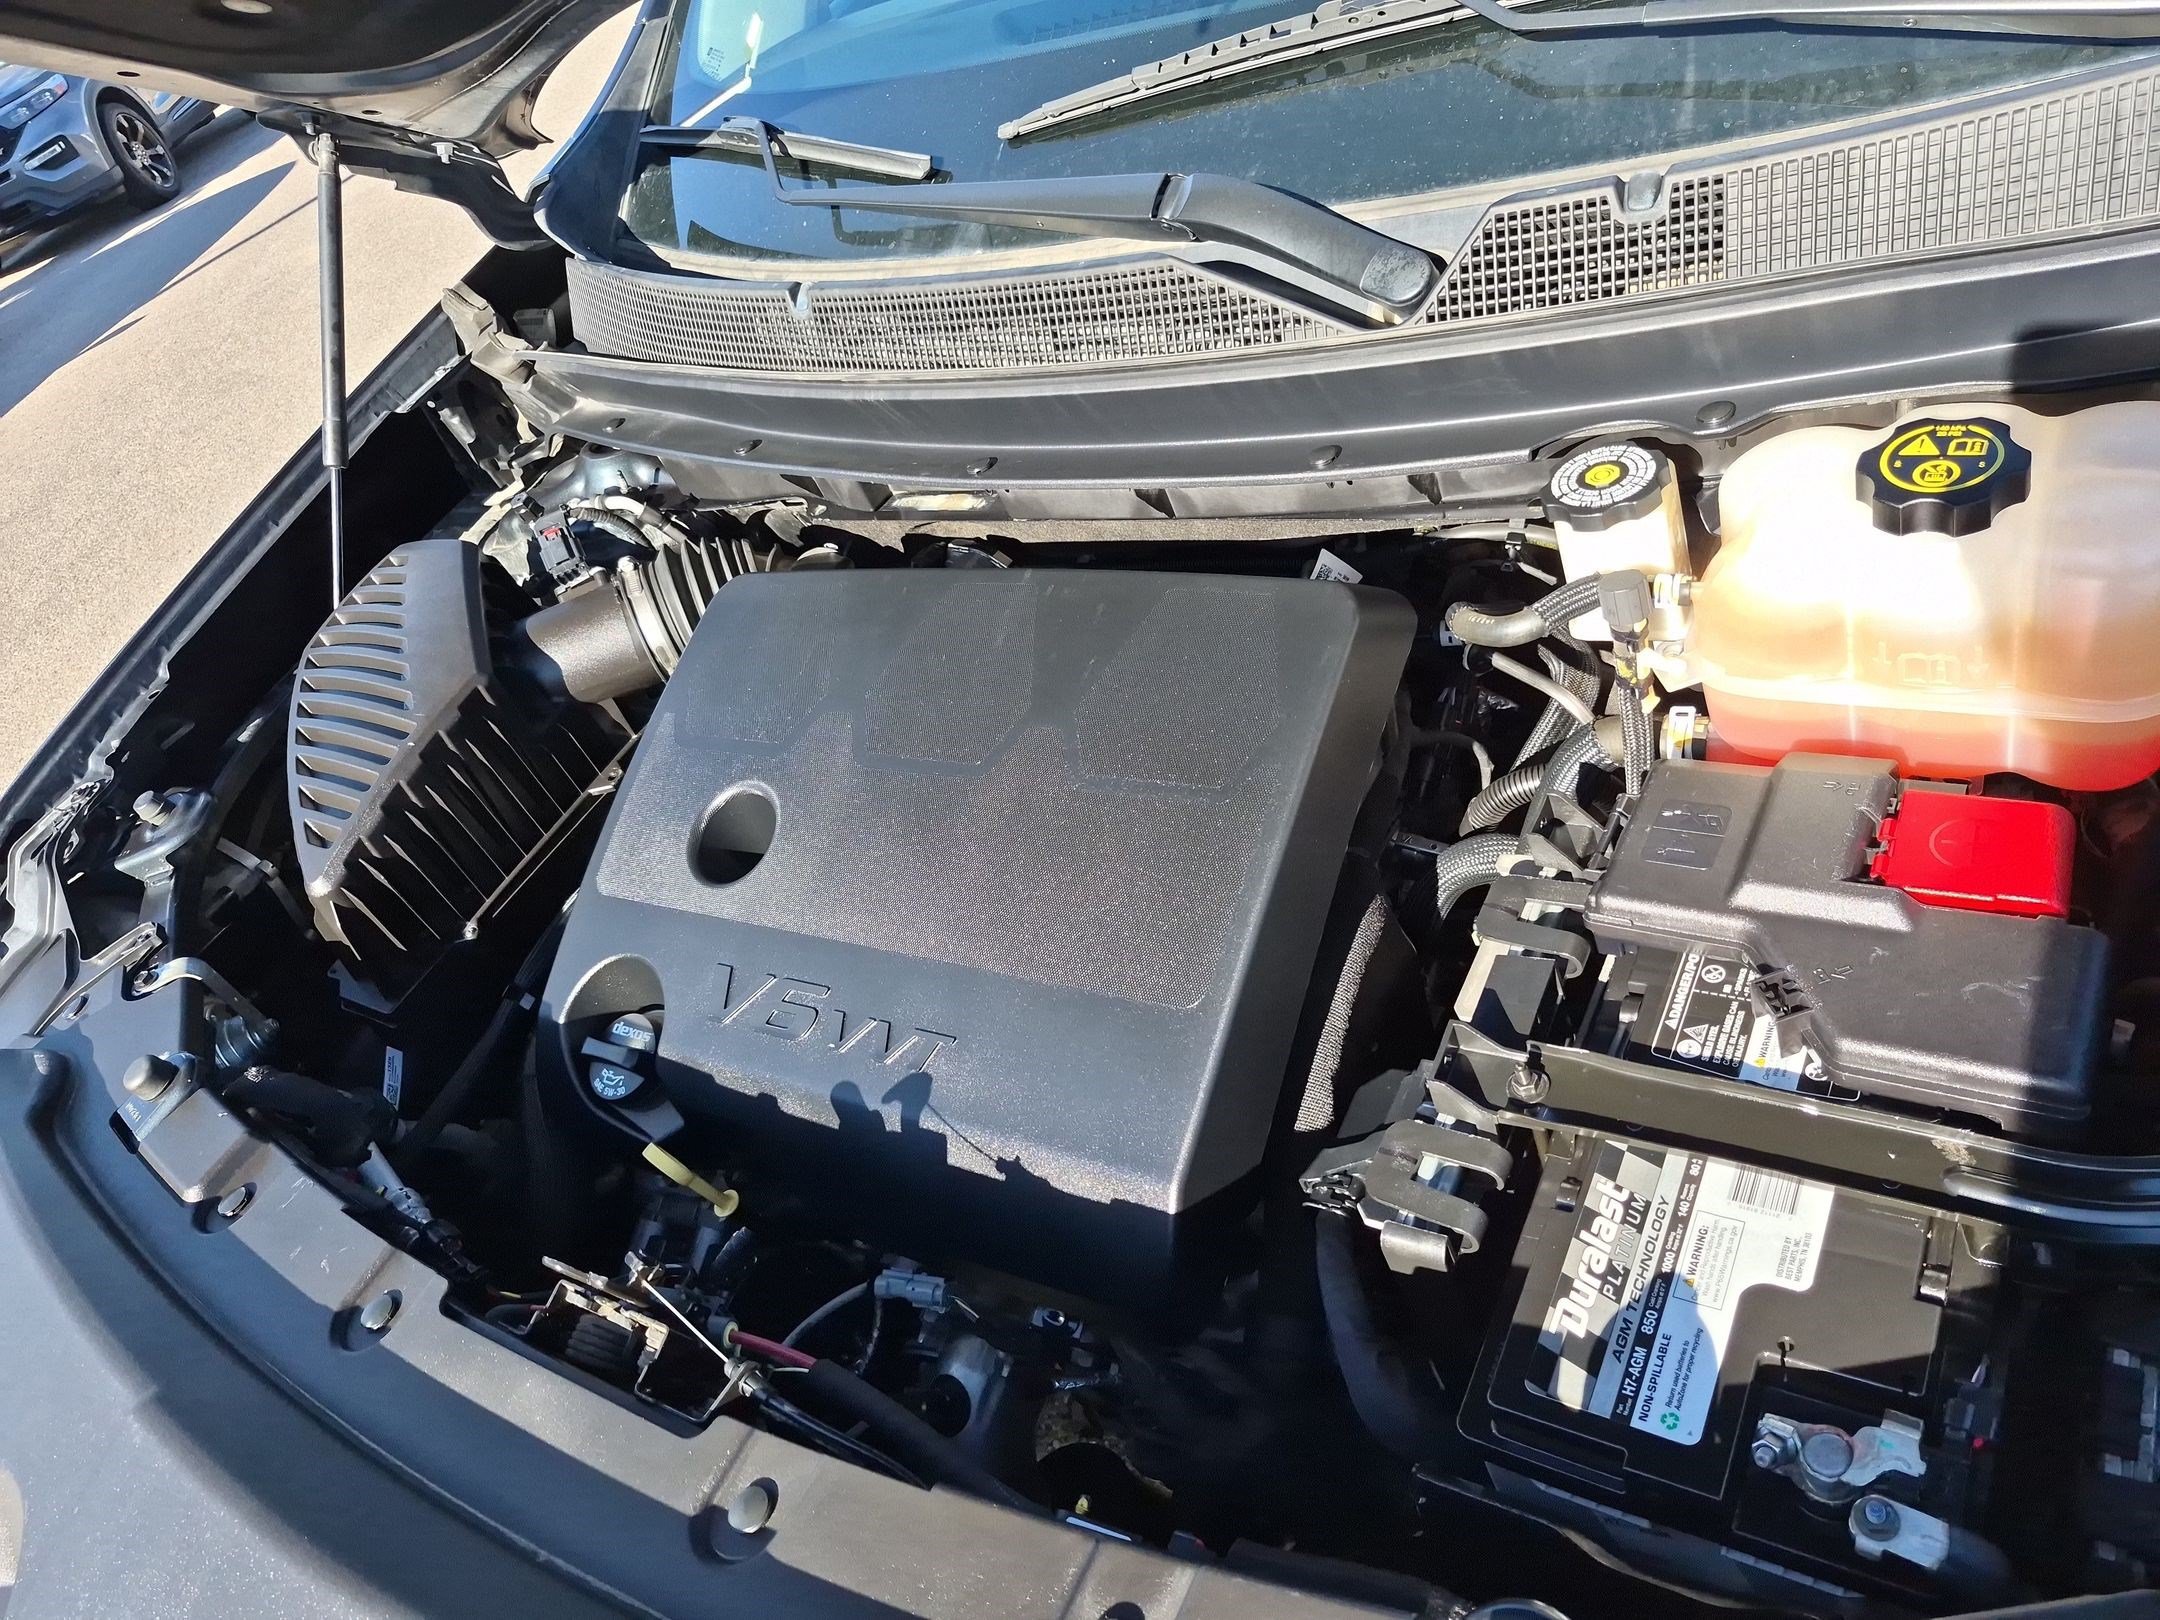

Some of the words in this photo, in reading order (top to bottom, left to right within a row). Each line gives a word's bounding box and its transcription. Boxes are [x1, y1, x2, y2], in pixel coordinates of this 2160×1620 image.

[717, 963, 831, 1041] V6
[612, 1022, 655, 1042] dexos
[1713, 1033, 1728, 1064] EXPLOSIVE
[1722, 1014, 1734, 1033] GASES
[1729, 1001, 1739, 1015] CAN
[1723, 1045, 1735, 1066] CAUSE
[1729, 1010, 1745, 1045] BLINDNESS
[1701, 1041, 1714, 1062] SHIELD
[1732, 1058, 1740, 1068] OR
[603, 1086, 626, 1097] 5W-30
[1689, 1164, 1701, 1177] 80
[1687, 1184, 1697, 1201] Capacity
[1677, 1201, 1690, 1218] 140
[1603, 1192, 1647, 1300] PLATINUM
[1666, 1232, 1676, 1250] Cranking
[1687, 1225, 1709, 1277] WARNING:
[1548, 1180, 1630, 1339] Duralast
[1661, 1251, 1676, 1275] 1000
[1776, 1245, 1790, 1278] DISTRIBUTED
[1612, 1317, 1633, 1364] AGM
[1626, 1195, 1669, 1313] TECHNOLOGY
[1652, 1279, 1662, 1297] Cranking
[1655, 1297, 1663, 1309] Amps
[1641, 1310, 1658, 1335] 850
[1622, 1347, 1647, 1397] H7-AGM
[1639, 1333, 1672, 1423] NON-SPILLABLE
[1665, 1388, 1676, 1408] Return
[1672, 1373, 1680, 1387] used
[1676, 1348, 1688, 1373] batteries
[1674, 1382, 1687, 1411] AutoZone
[1682, 1373, 1690, 1382] for
[1686, 1354, 1696, 1373] proper
[1623, 1398, 1632, 1416] Number
